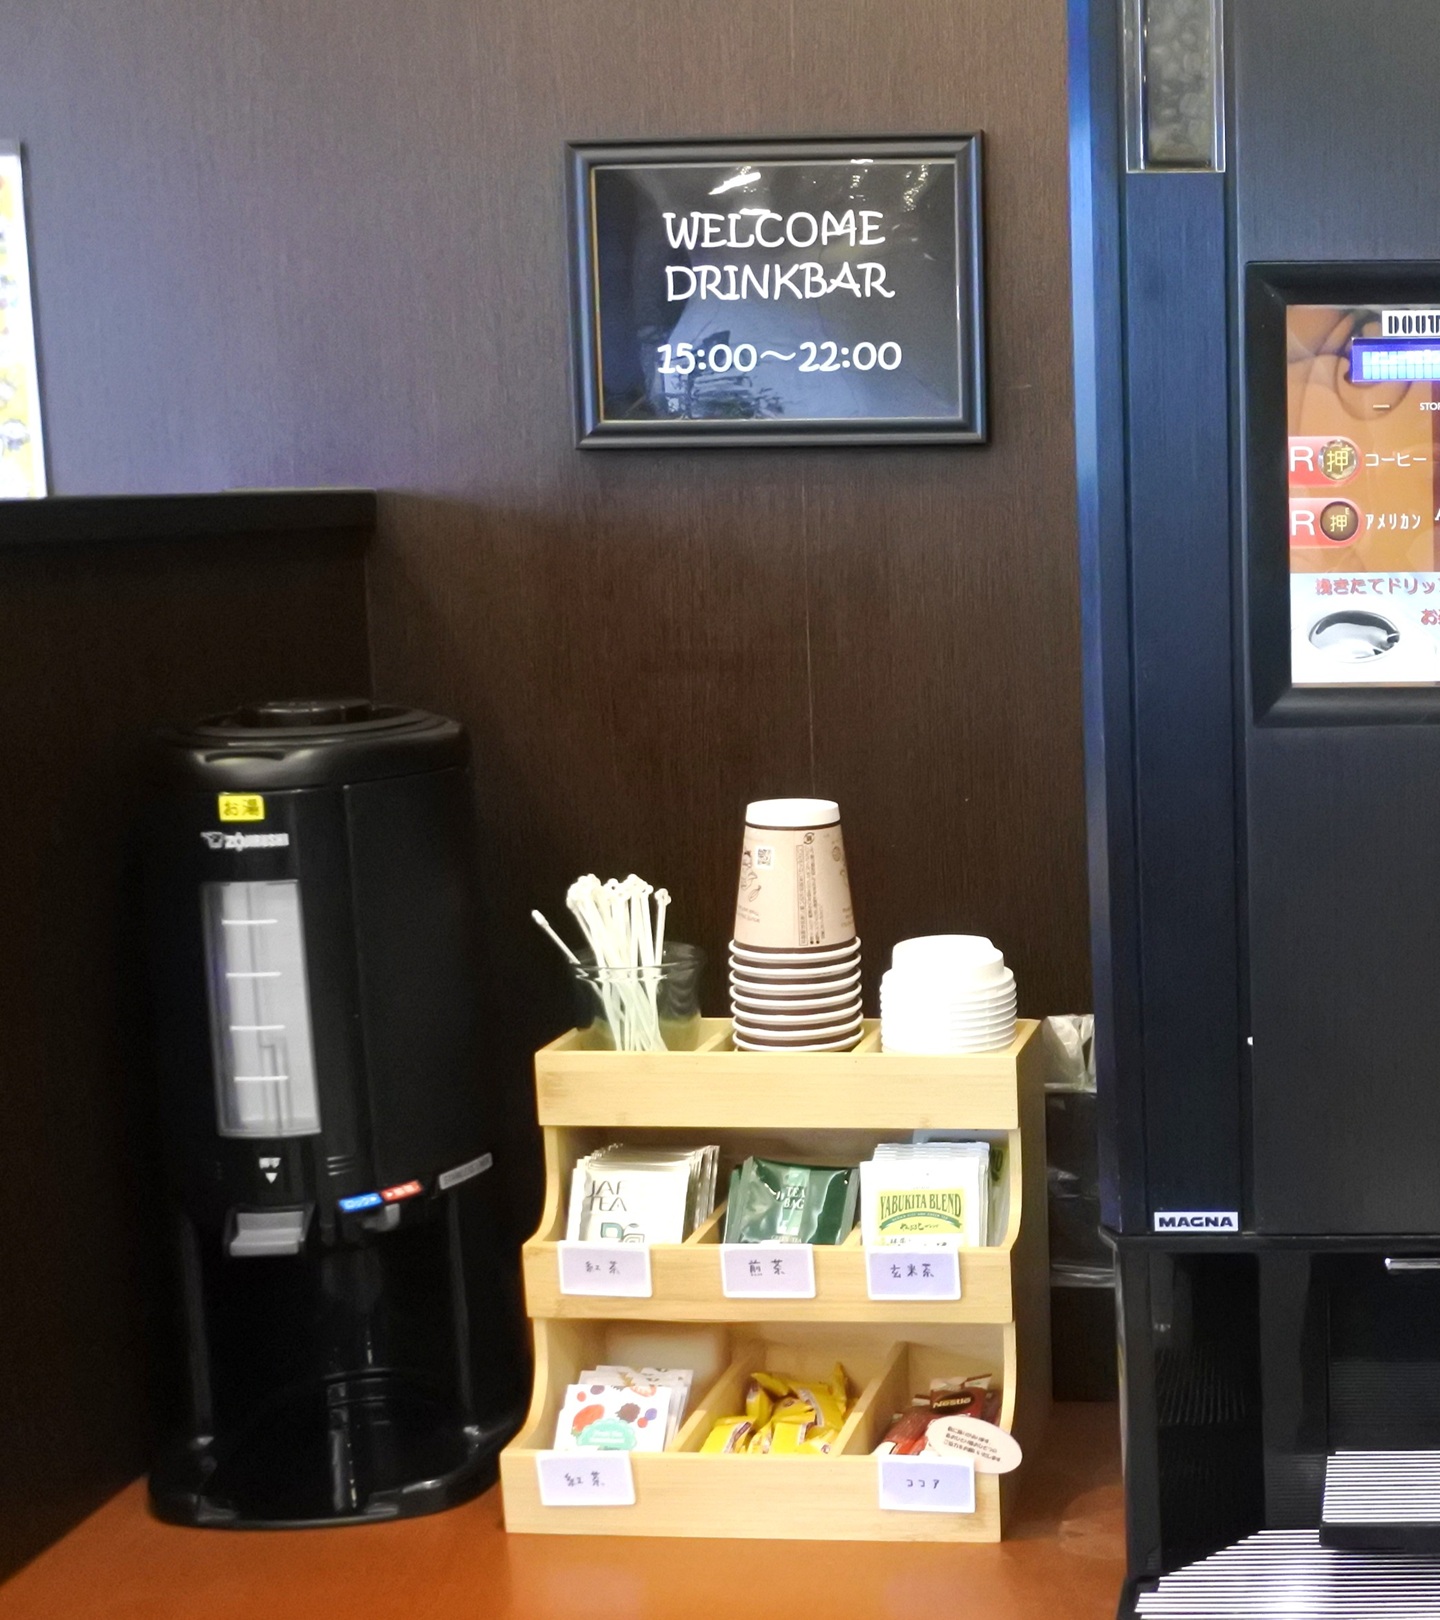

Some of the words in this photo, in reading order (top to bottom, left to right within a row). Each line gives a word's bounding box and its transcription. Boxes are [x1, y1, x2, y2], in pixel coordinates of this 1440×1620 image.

[662, 208, 886, 251] WELCOME
[664, 261, 897, 302] DRINKBAR
[1325, 449, 1350, 473] 押
[1365, 452, 1428, 469] コーヒー
[1329, 513, 1348, 532] 押
[1365, 512, 1423, 531] アメリカン
[880, 1193, 927, 1221] YABUKITA
[929, 1193, 962, 1218] BLEND
[1158, 1215, 1234, 1228] MAGNA
